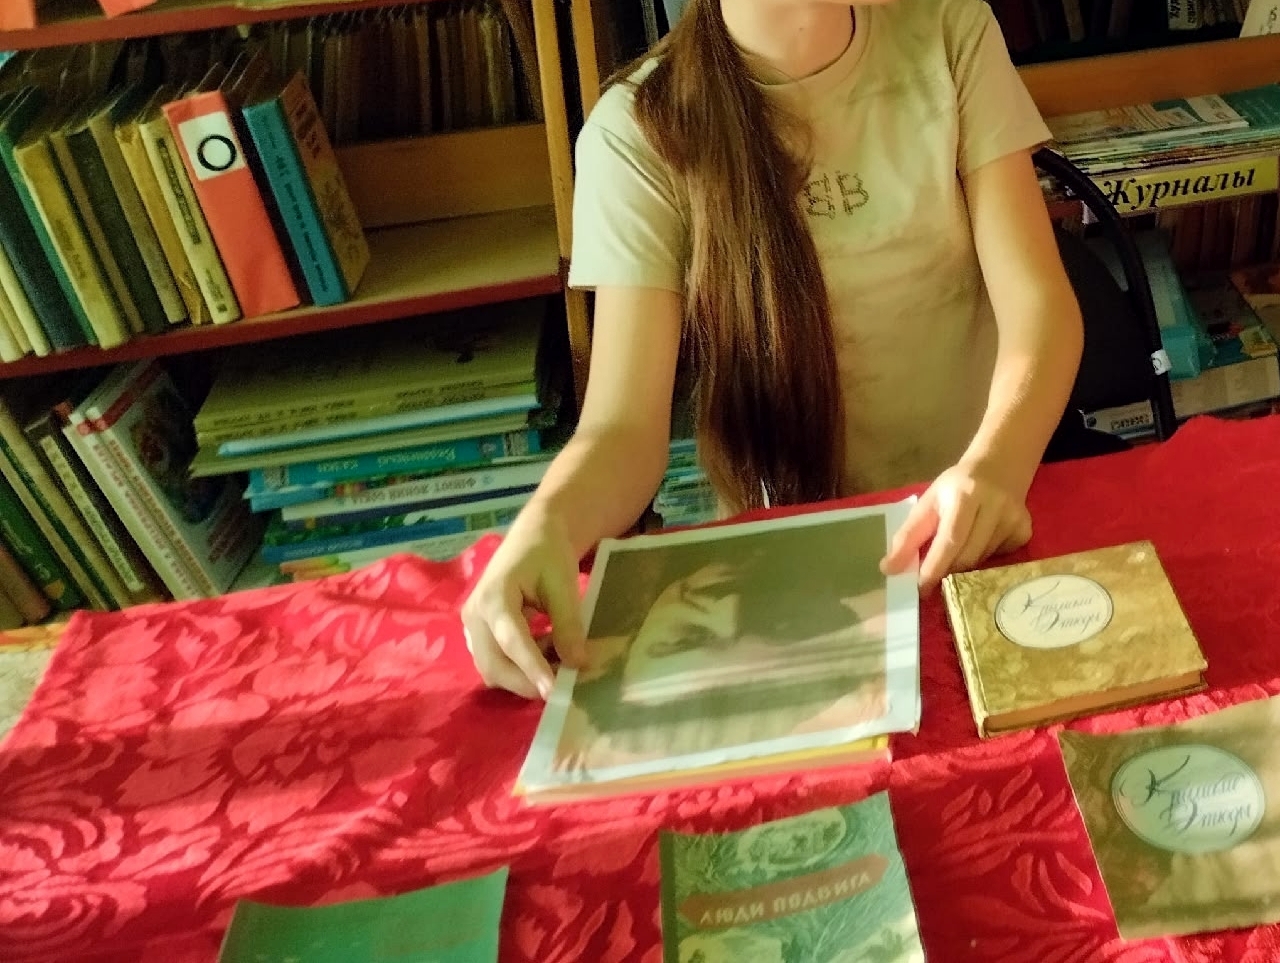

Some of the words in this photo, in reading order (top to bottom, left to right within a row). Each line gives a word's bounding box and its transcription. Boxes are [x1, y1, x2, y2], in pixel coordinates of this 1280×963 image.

[1102, 167, 1256, 207] Журналы
[700, 903, 764, 925] ЛЮДИ
[772, 872, 871, 913] ПОДВИГА
